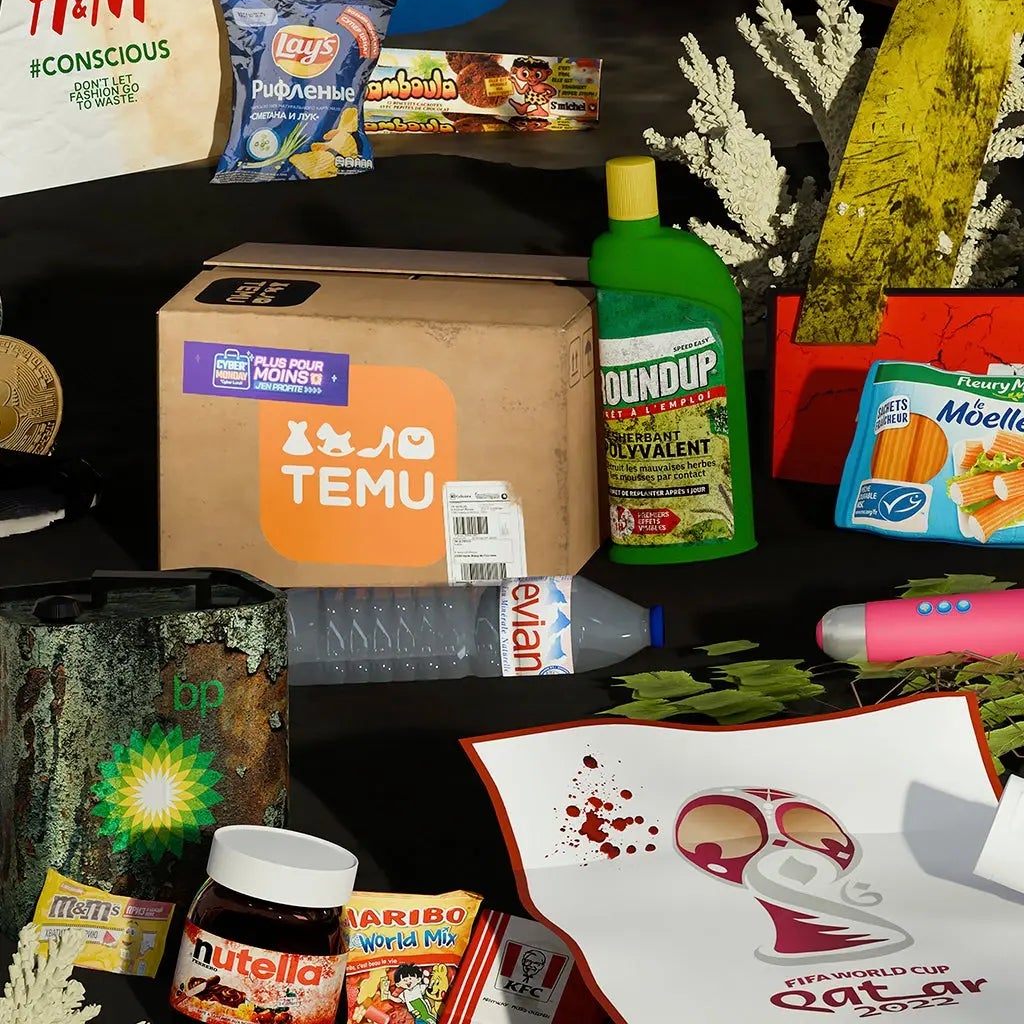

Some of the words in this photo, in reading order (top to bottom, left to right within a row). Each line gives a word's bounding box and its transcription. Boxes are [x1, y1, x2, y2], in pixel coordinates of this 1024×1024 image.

[30, 39, 170, 78] #CONSCIOUS
[275, 33, 336, 65] Lay's
[74, 78, 109, 91] DON'T
[112, 74, 132, 86] LET
[252, 79, 355, 101] Рифленые
[365, 68, 458, 101] amboula
[70, 85, 119, 102] FASHION
[123, 83, 139, 94] GO
[77, 100, 92, 110] TO
[94, 94, 138, 108] WASTE.
[364, 117, 456, 133] amboula
[673, 344, 693, 352] SPEED
[694, 337, 709, 347] EASY
[216, 360, 246, 370] CYBER
[254, 356, 287, 368] PLUS
[289, 359, 324, 371] POUR
[216, 370, 247, 380] MONDAY
[254, 367, 309, 384] MOINS
[957, 375, 1011, 394] Fleury
[646, 391, 711, 413] L'EMPLOI
[878, 398, 907, 419] SACHETS
[974, 399, 984, 410] le
[607, 431, 680, 444] SHERBANT
[608, 439, 710, 459] OLYVALENT
[626, 463, 637, 472] les
[640, 461, 685, 472] mauvaises
[687, 460, 716, 468] herbes
[674, 470, 706, 479] contact
[281, 465, 434, 509] TEMU
[511, 583, 546, 672] evian
[173, 672, 225, 718] bp
[360, 931, 416, 953] World
[424, 927, 458, 947] Mix
[193, 938, 323, 986] nutella
[784, 975, 830, 988] FIFA
[830, 967, 907, 979] WORLD
[910, 965, 950, 975] CUP
[504, 980, 543, 998] KFC
[770, 978, 988, 1013] Qatar
[854, 997, 959, 1018] 2022
